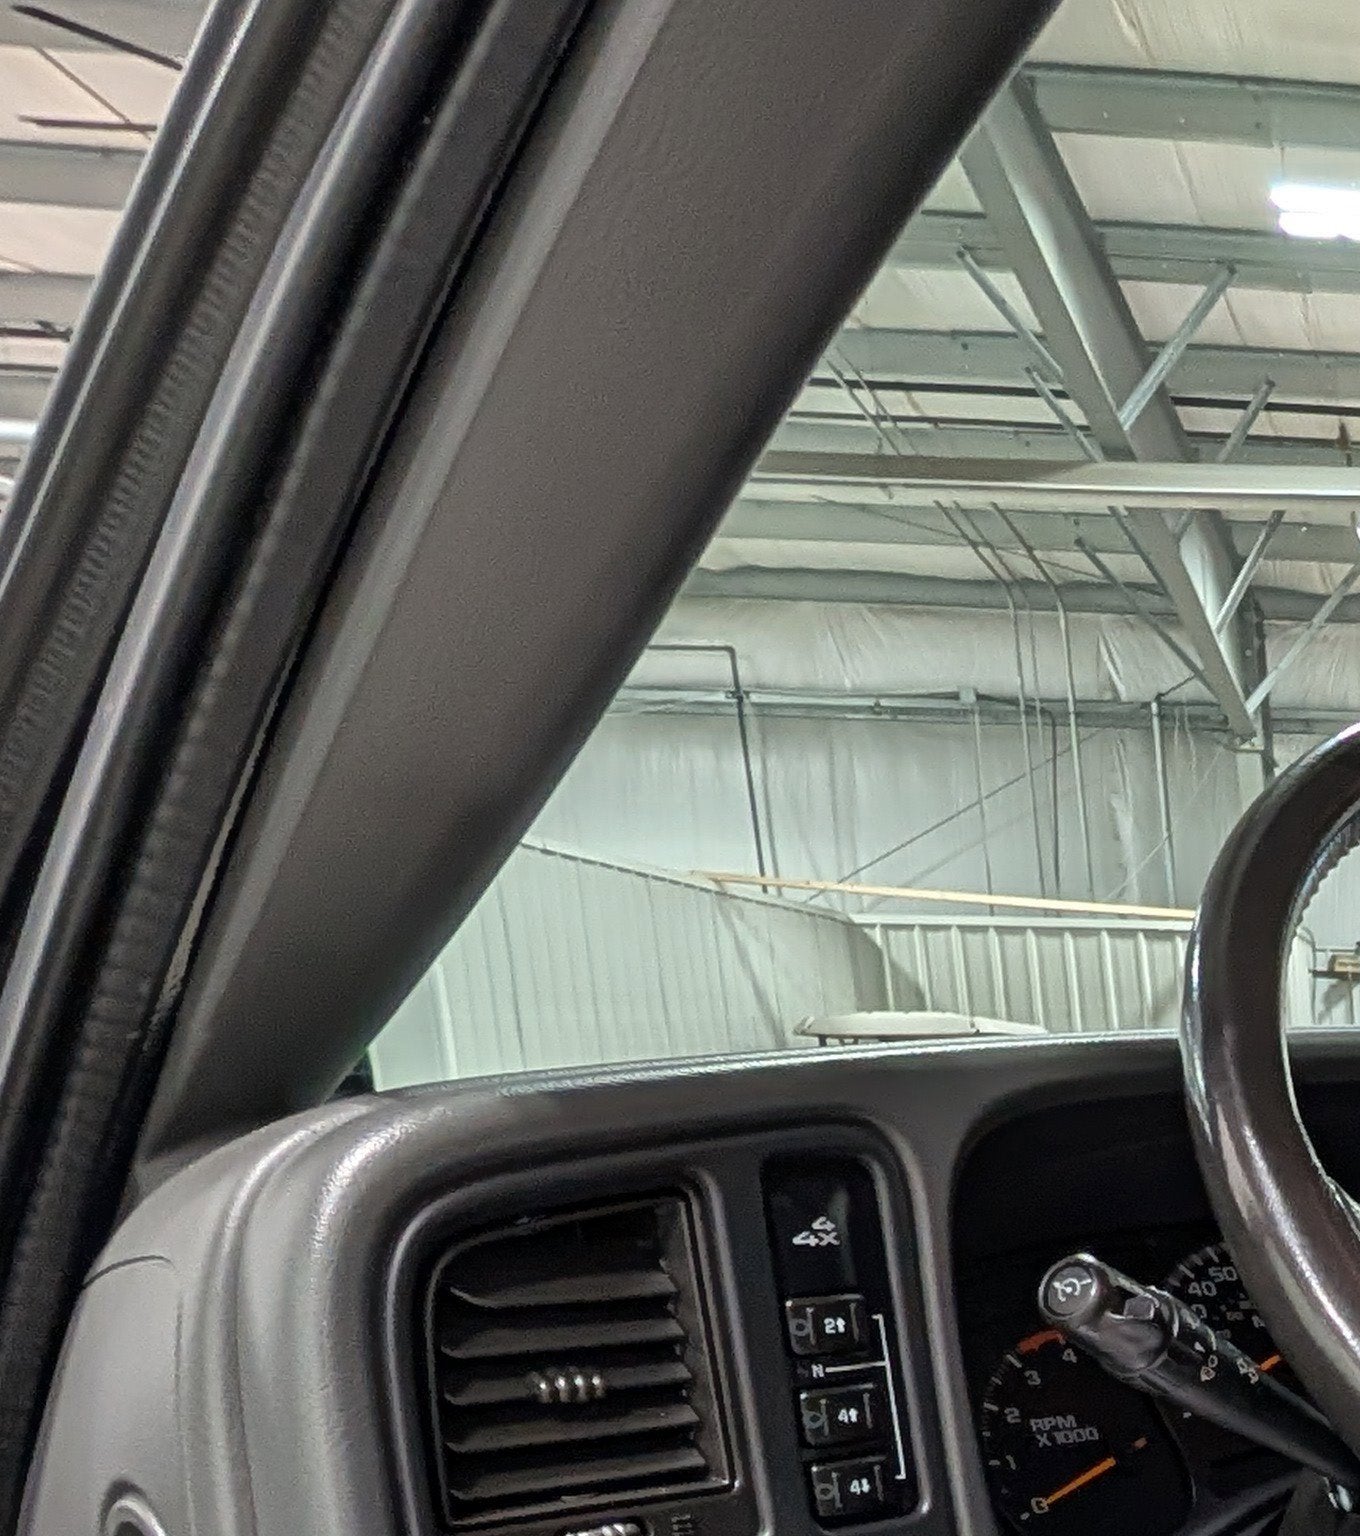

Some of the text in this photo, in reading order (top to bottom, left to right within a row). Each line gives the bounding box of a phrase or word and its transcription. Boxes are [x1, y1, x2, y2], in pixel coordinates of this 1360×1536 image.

[1208, 1266, 1237, 1283] 50
[1188, 1281, 1217, 1297] 40
[1062, 1349, 1077, 1363] 4
[1024, 1370, 1041, 1386] 3
[1004, 1407, 1021, 1423] 2
[1030, 1415, 1077, 1432] RPM
[1055, 1427, 1099, 1445] 1000
[1005, 1454, 1017, 1470] 1
